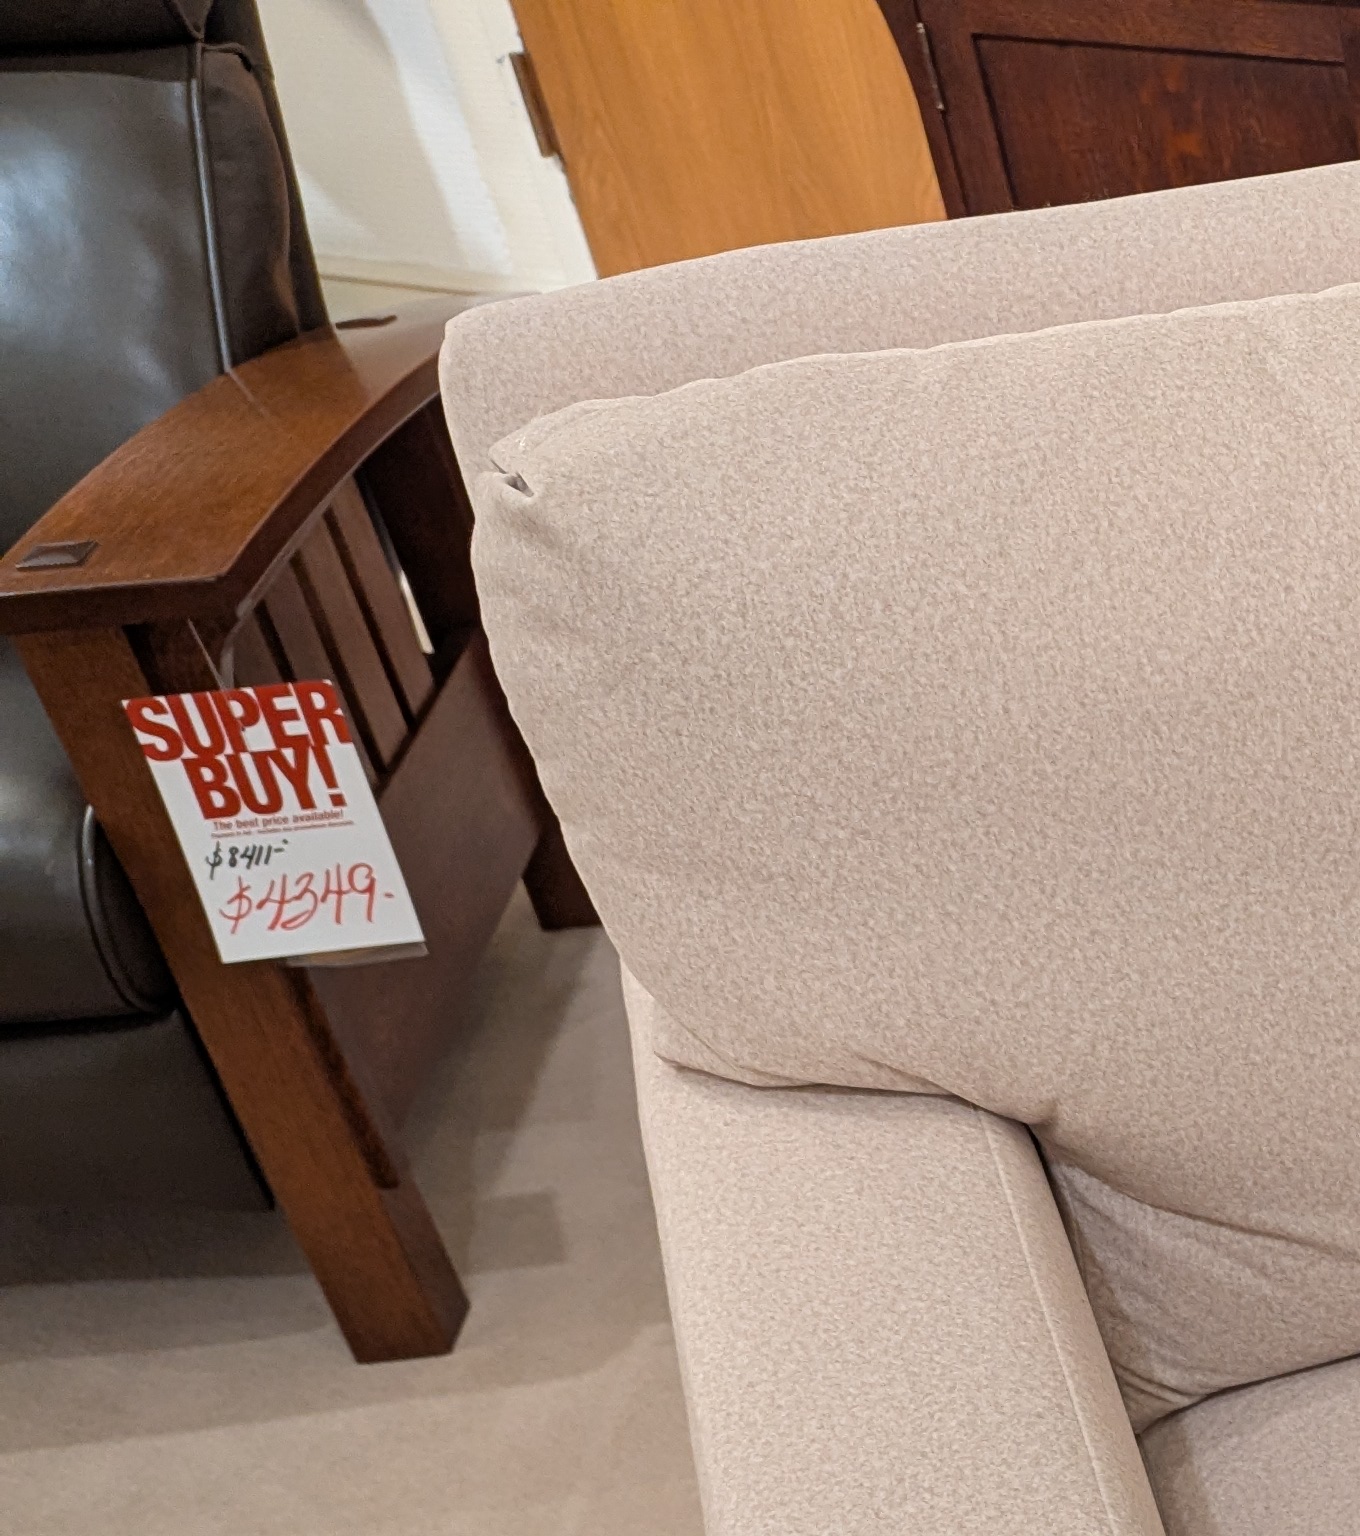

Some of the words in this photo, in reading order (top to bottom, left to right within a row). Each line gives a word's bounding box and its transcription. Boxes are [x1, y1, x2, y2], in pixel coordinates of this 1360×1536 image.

[126, 680, 353, 761] SUPER
[182, 744, 347, 819] BUY!
[213, 821, 233, 831] The
[236, 818, 258, 829] best
[262, 815, 288, 828] price
[292, 809, 343, 823] available!
